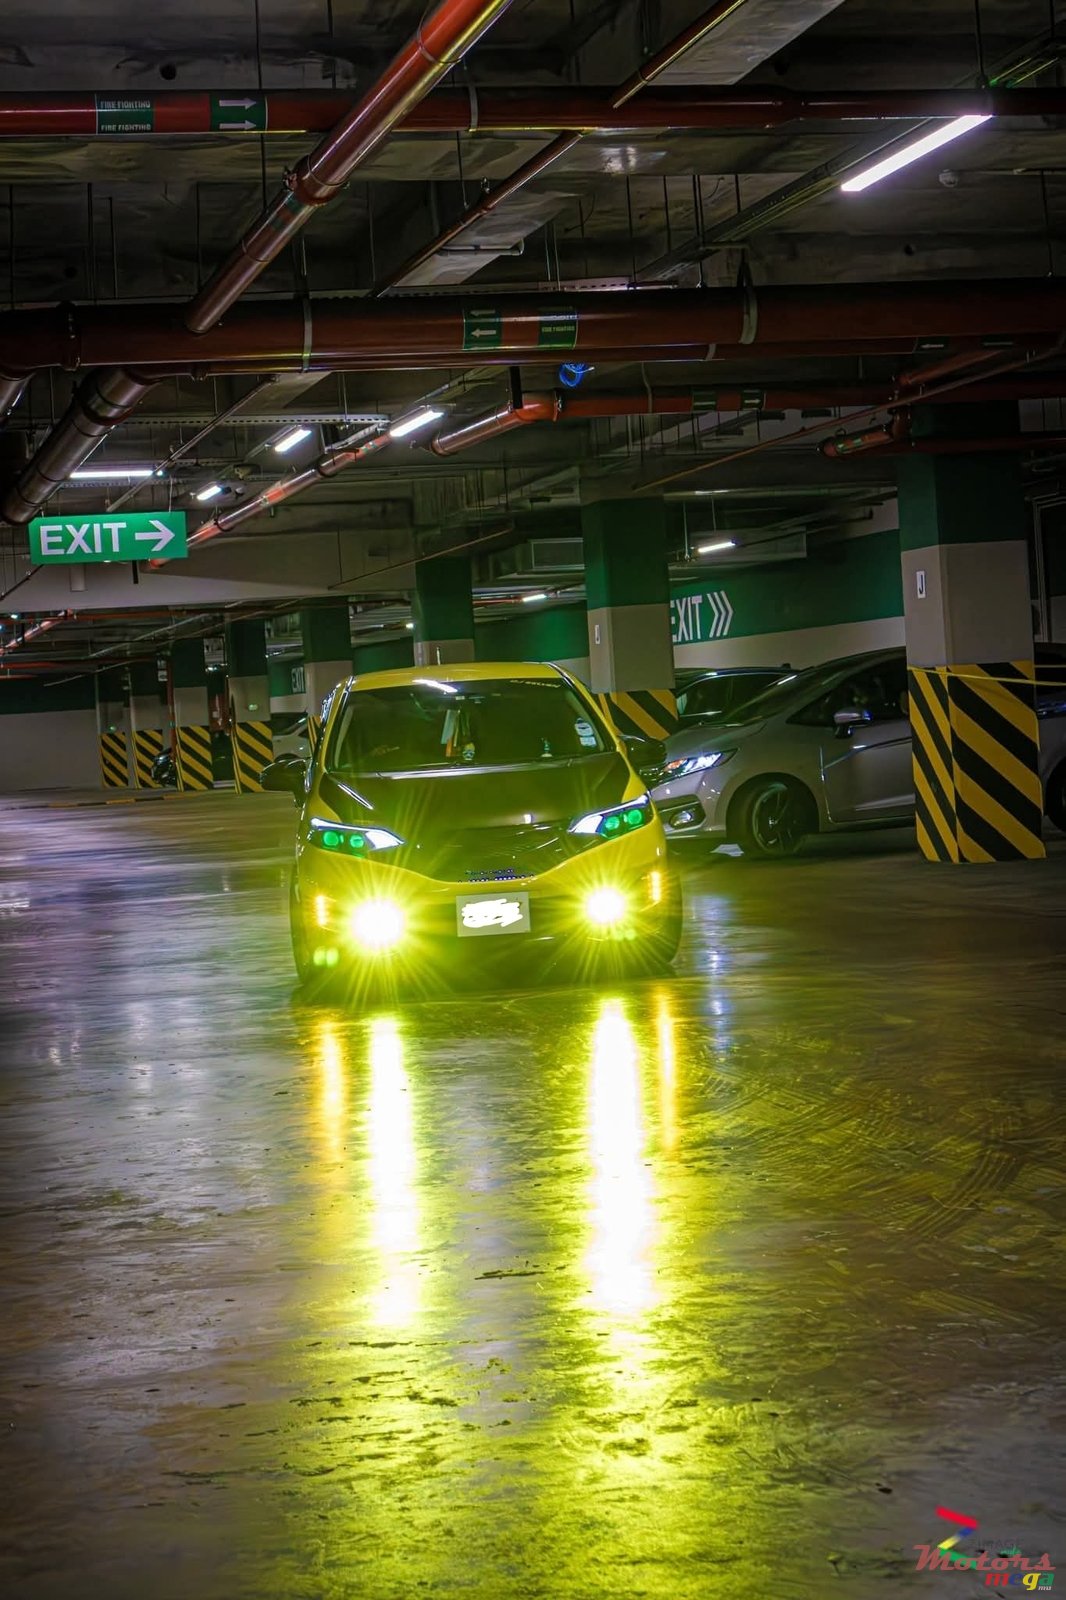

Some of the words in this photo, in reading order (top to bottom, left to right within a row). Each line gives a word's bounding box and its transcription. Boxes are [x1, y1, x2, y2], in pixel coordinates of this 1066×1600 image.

[100, 100, 116, 109] FIRE
[100, 124, 117, 132] FIRE
[39, 521, 127, 556] EXIT
